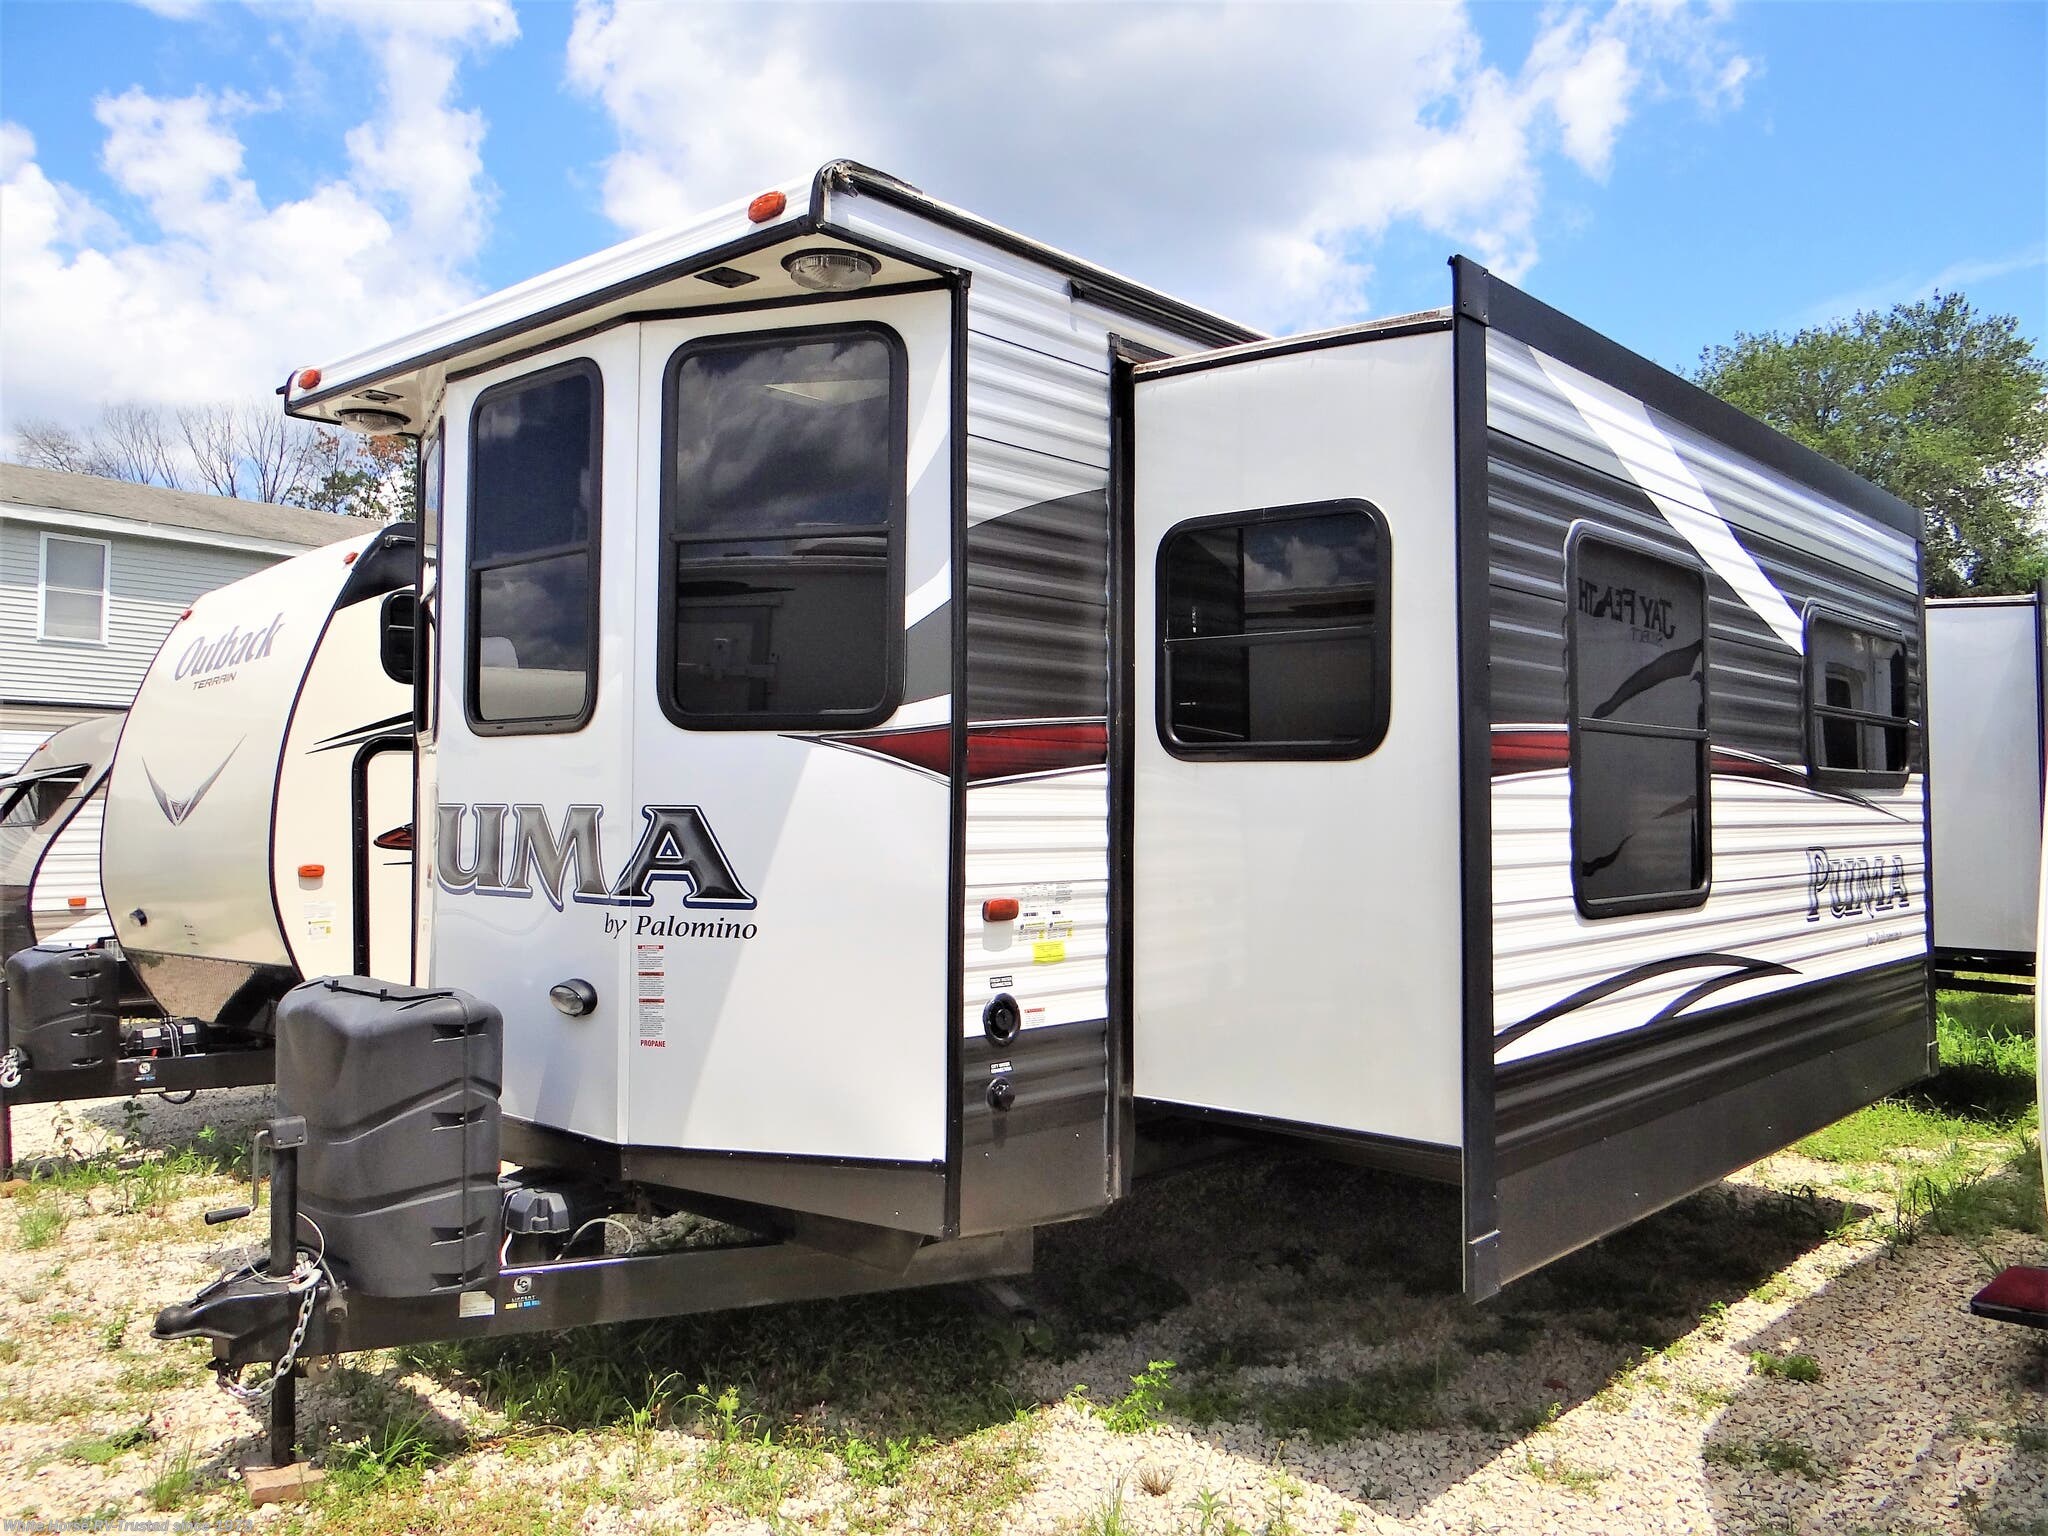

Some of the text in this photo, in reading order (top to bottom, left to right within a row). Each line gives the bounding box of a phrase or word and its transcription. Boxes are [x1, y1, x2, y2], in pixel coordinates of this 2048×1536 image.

[174, 611, 286, 681] Outback
[192, 671, 238, 691] TERRAIN
[1805, 845, 1910, 923] PUMA
[604, 912, 758, 940] by Palomino
[640, 1039, 667, 1048] PROPANE
